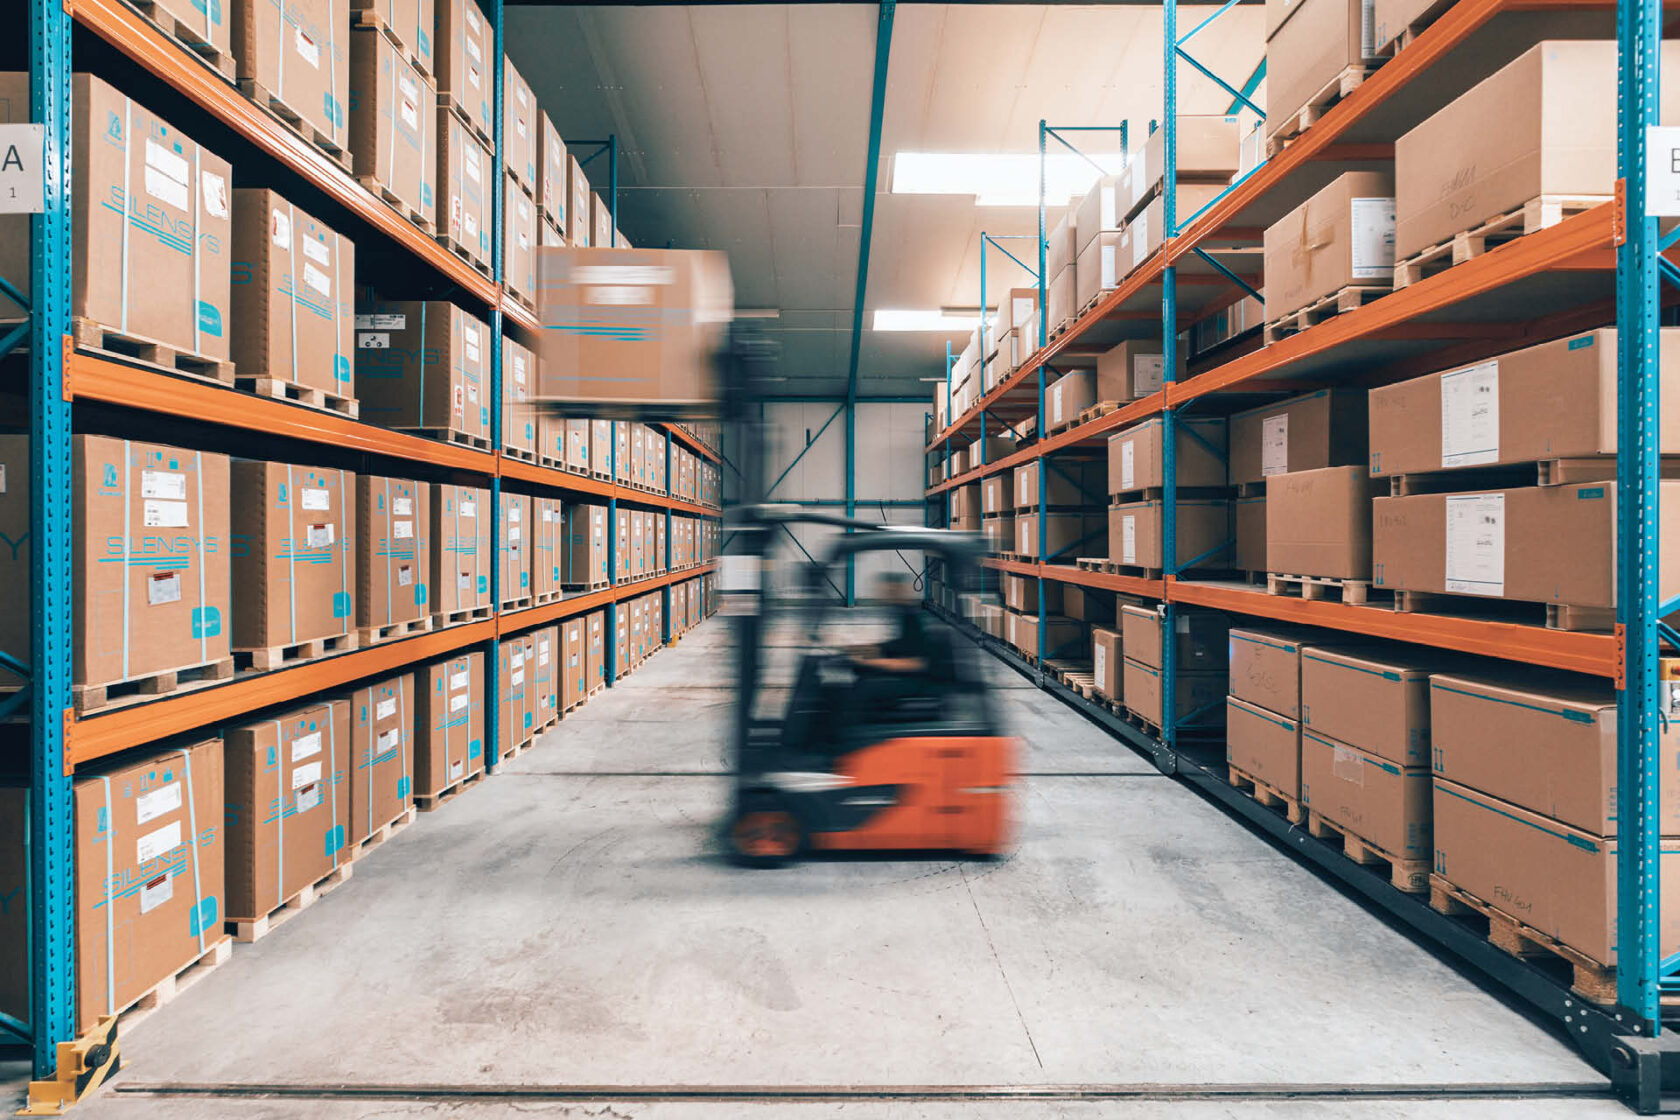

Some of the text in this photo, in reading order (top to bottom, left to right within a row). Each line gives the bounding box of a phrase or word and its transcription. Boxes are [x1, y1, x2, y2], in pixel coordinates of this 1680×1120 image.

[2, 145, 24, 172] A
[9, 187, 17, 198] 1
[106, 536, 219, 555] SLENSYS
